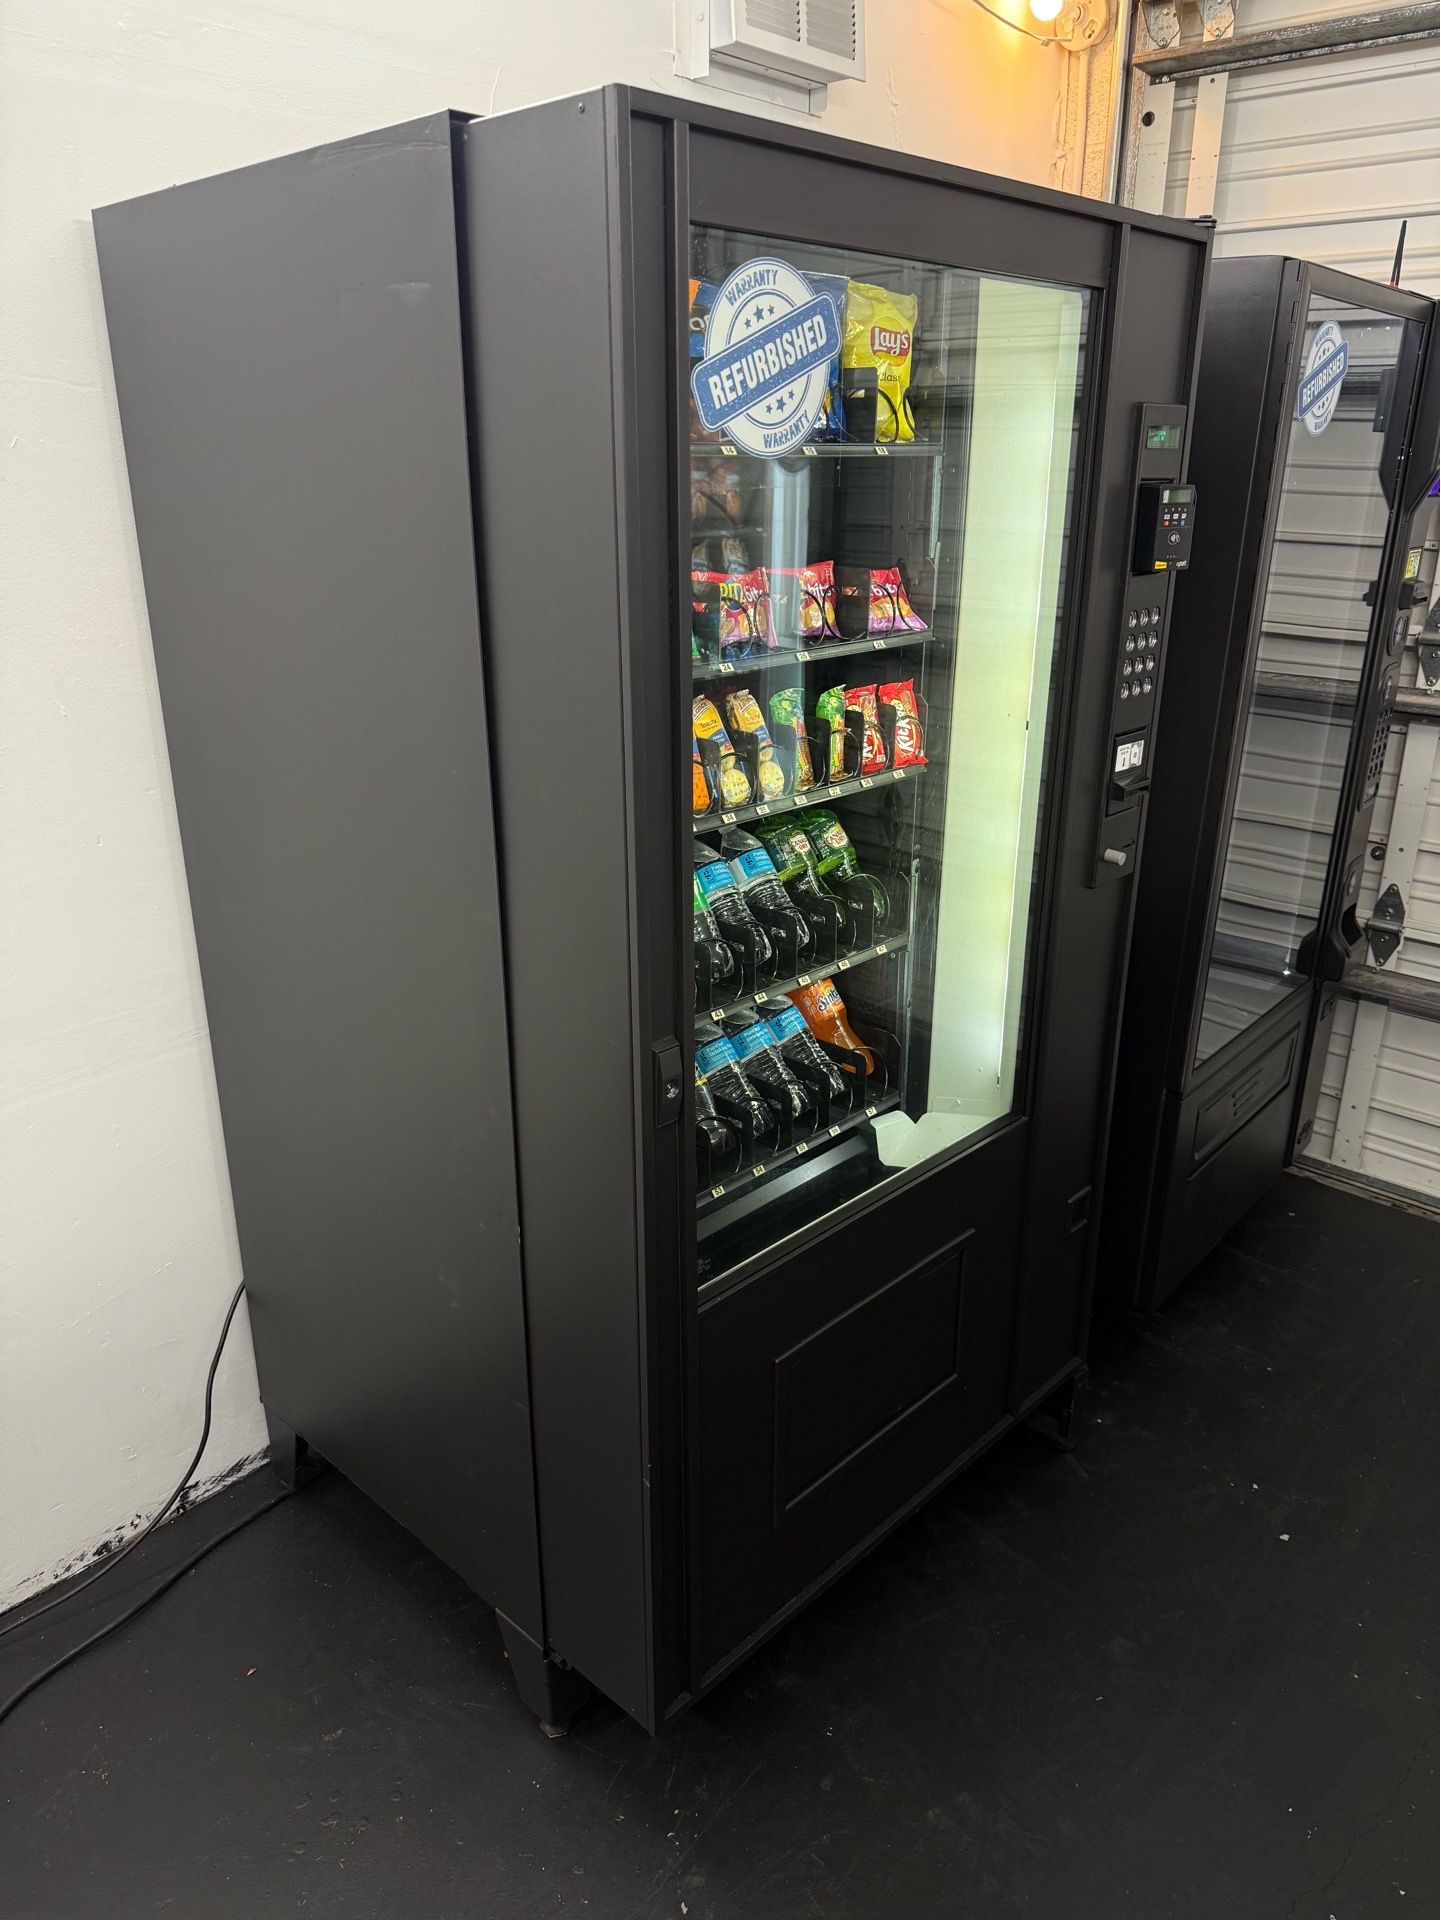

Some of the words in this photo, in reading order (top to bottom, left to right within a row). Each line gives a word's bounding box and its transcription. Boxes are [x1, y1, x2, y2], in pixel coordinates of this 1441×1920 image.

[724, 268, 778, 306] WARRANTY
[708, 314, 827, 411] REFURBISHED
[873, 327, 909, 357] Lay's
[1302, 352, 1345, 407] REFURBISHED
[763, 409, 811, 450] WARRANTY
